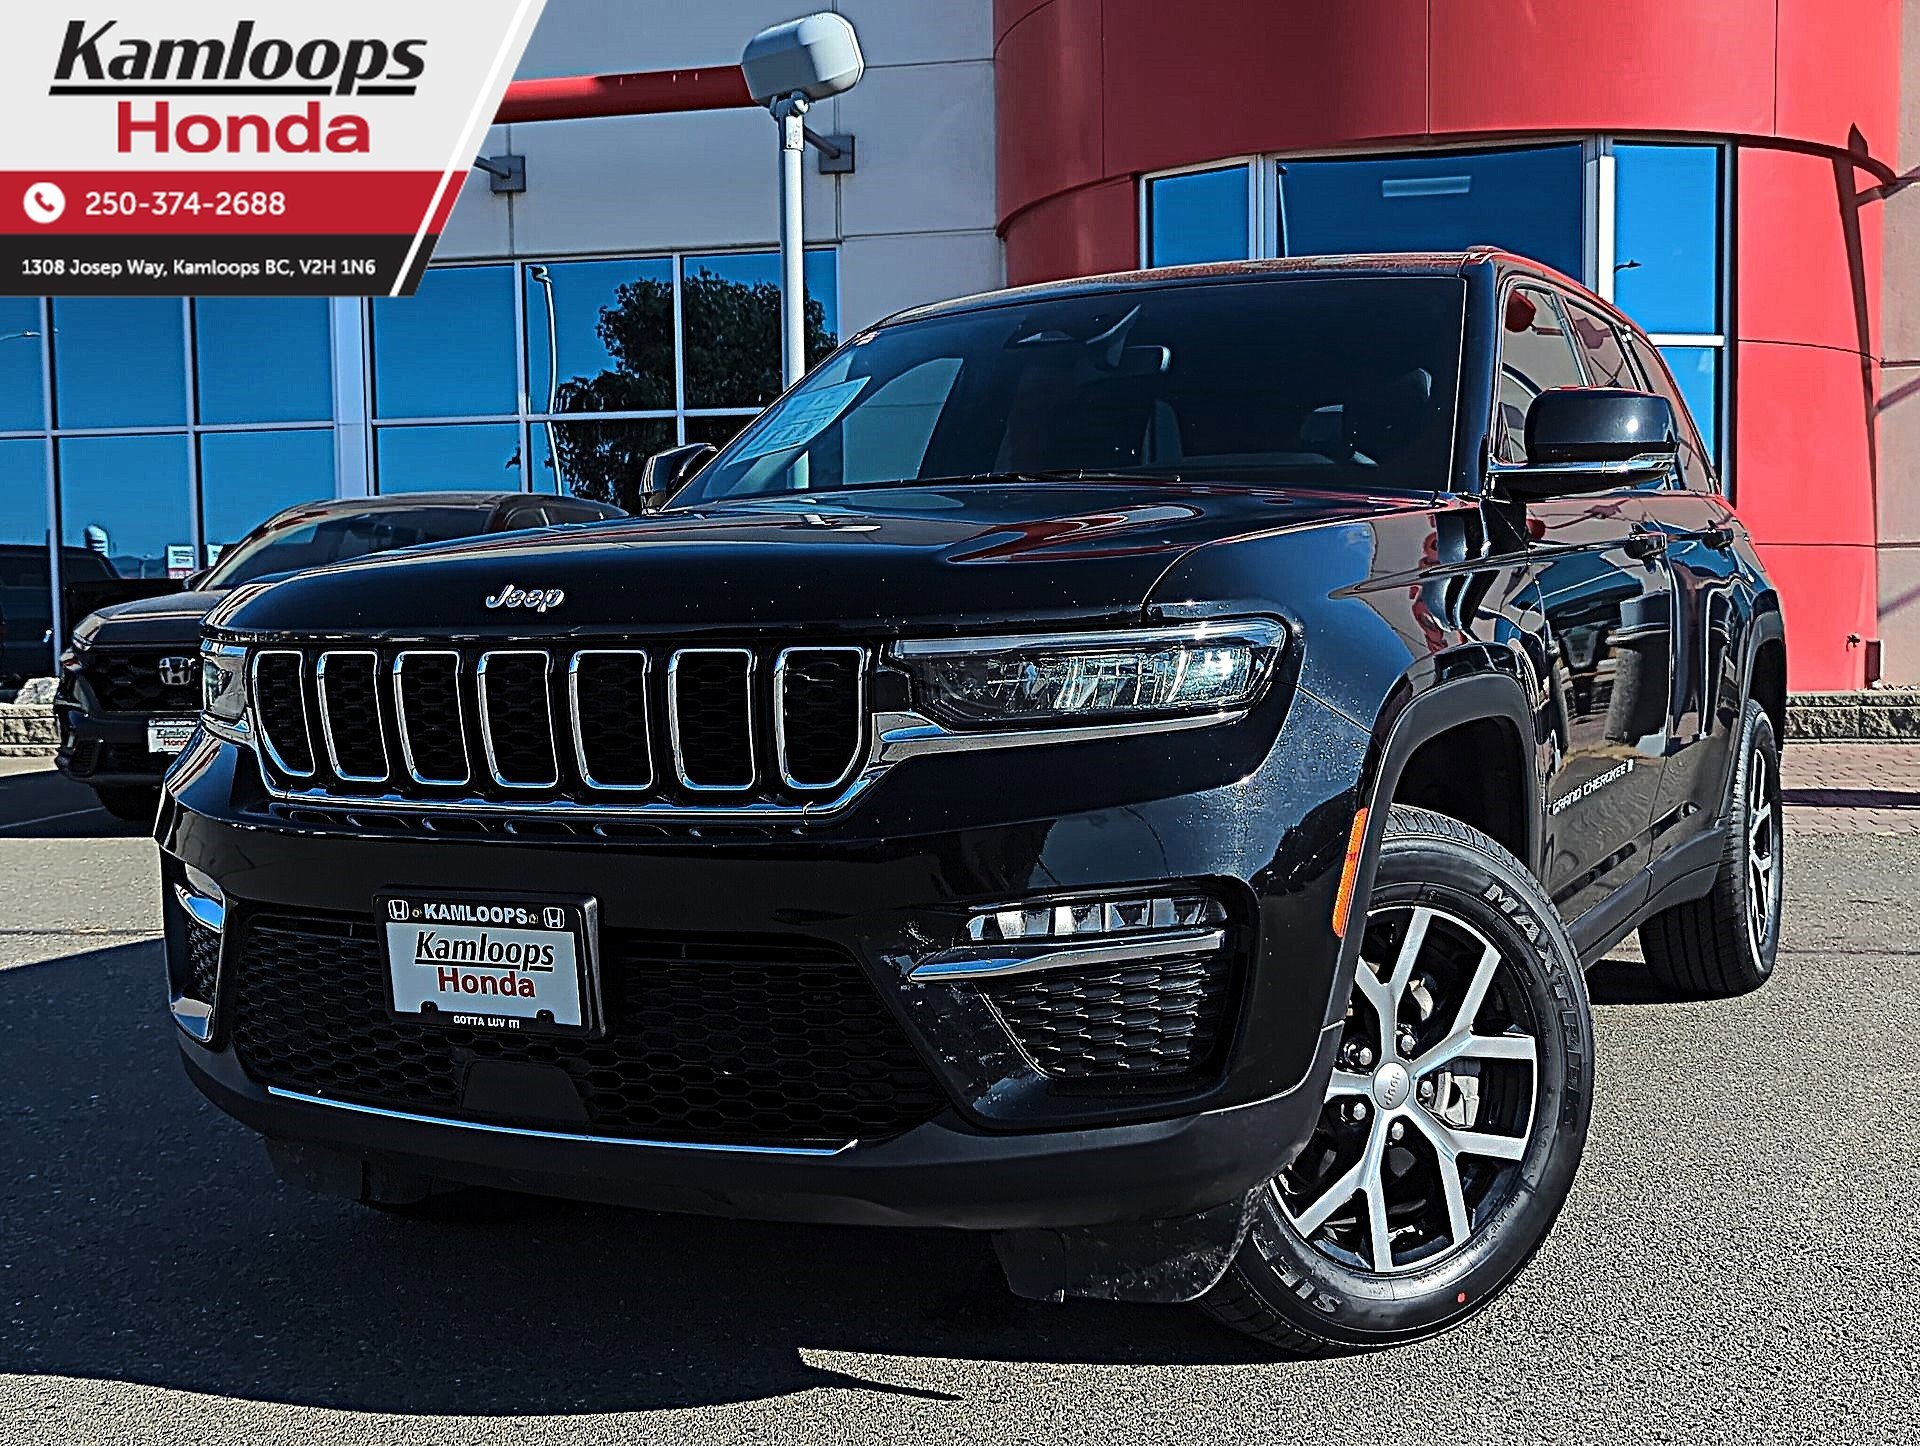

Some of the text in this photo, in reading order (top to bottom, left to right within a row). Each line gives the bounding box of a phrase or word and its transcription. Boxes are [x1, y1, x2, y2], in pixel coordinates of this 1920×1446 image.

[485, 584, 565, 612] Jeep
[1552, 762, 1627, 815] GRAND CHEROKEE
[423, 903, 529, 925] KAMLOOPS
[415, 930, 554, 972] Kamloops
[437, 967, 536, 998] Honda
[453, 1015, 485, 1027] GOTTA
[487, 1017, 506, 1028] LUV
